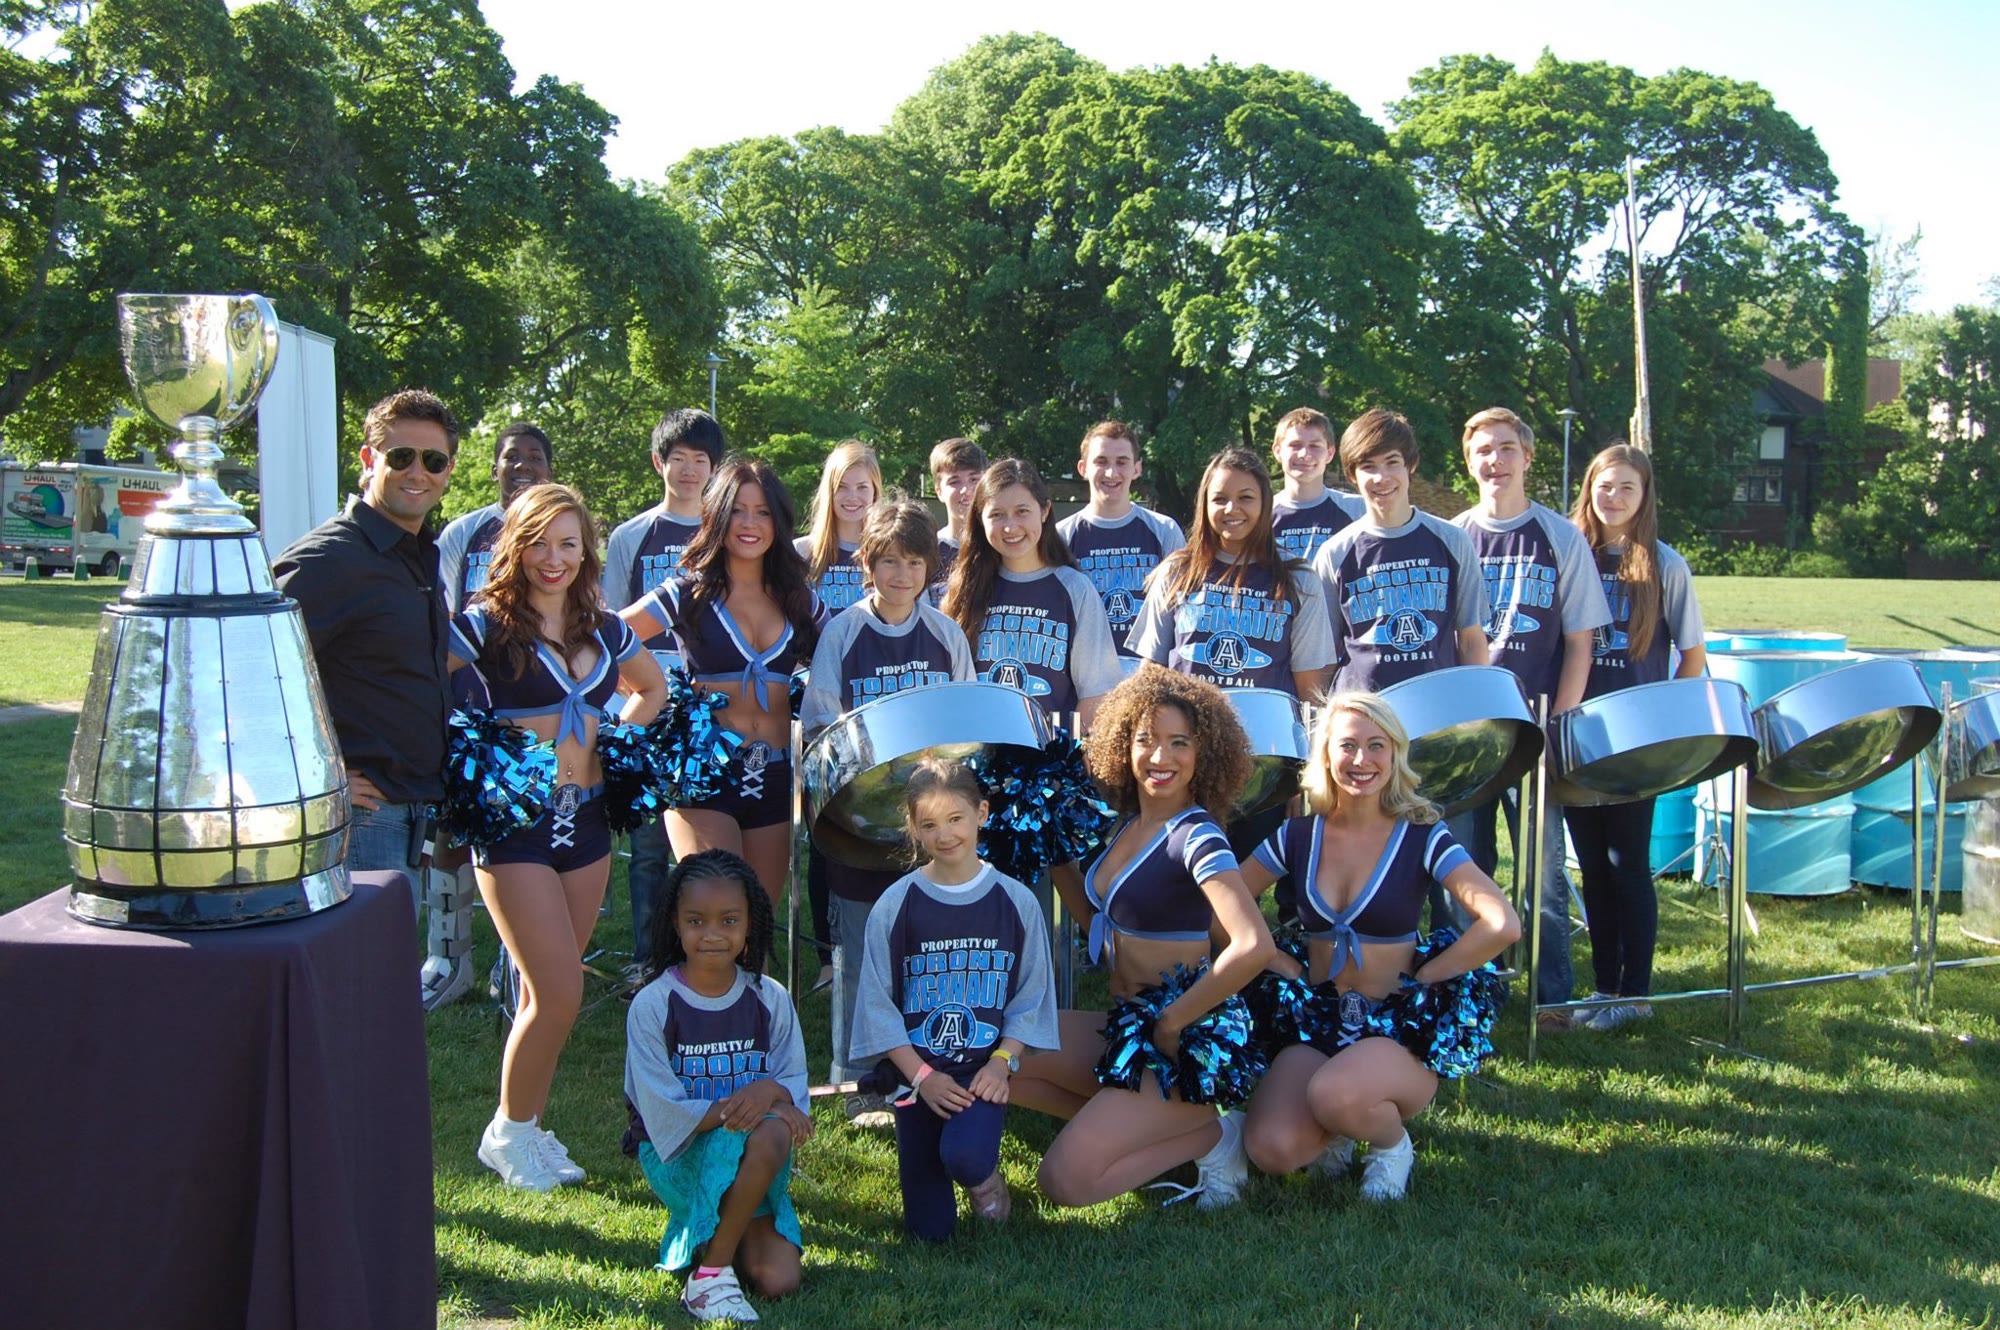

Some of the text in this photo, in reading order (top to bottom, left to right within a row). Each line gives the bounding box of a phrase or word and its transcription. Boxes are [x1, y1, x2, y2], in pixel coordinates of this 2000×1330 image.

[1090, 547, 1131, 556] PROPERTY
[1080, 554, 1159, 570] ORONTO
[1366, 558, 1430, 575] PROPERTY OF
[1254, 590, 1268, 598] OF
[1035, 608, 1049, 617] OF
[1107, 593, 1129, 617] A
[981, 614, 1069, 641] RONTO
[1395, 615, 1421, 643] A
[977, 631, 1068, 671] GONAUTS
[1213, 638, 1239, 667] A
[998, 664, 1020, 688] A
[921, 938, 999, 953] PROPERTY OF
[933, 1012, 965, 1048] A
[677, 1040, 743, 1055] PROPERTY
